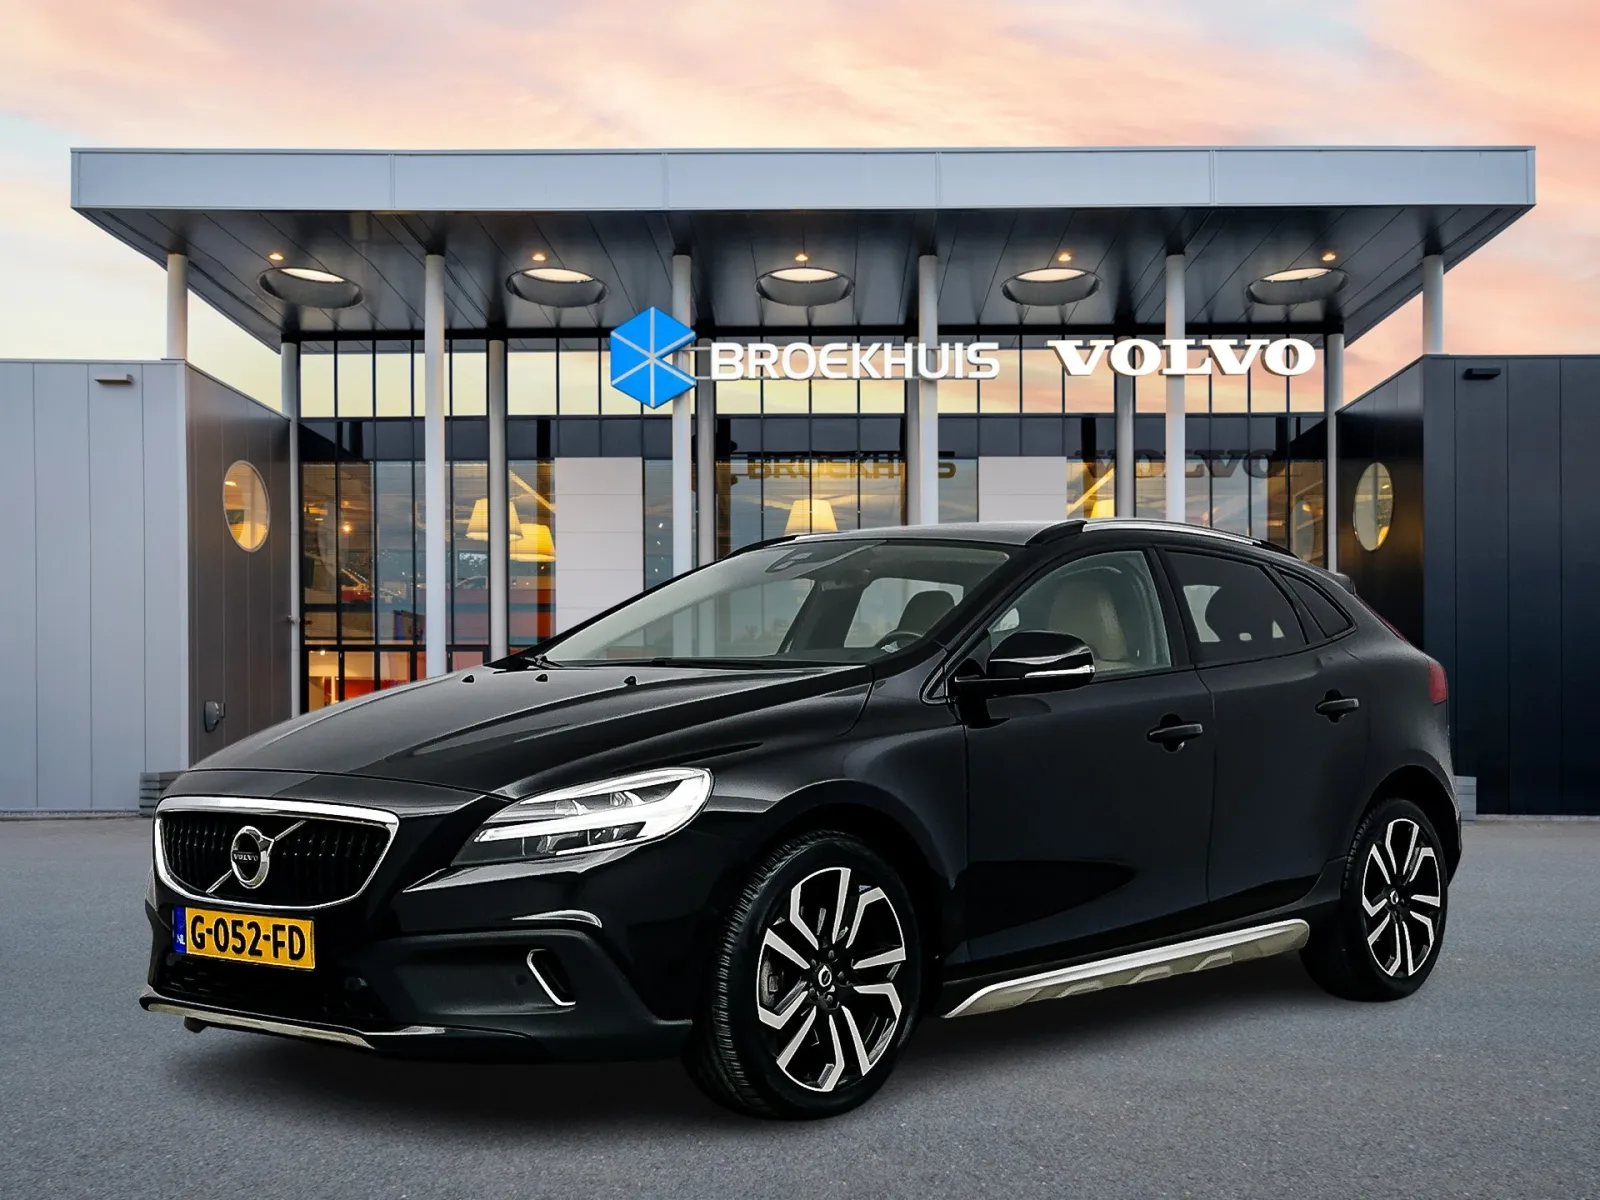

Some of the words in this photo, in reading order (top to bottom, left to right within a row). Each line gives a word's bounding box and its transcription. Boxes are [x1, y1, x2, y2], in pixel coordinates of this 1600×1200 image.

[711, 342, 1000, 379] BROEKHUIS
[1047, 338, 1316, 375] VOLVO
[233, 853, 259, 862] VOLVO
[191, 914, 306, 960] G-052-FD
